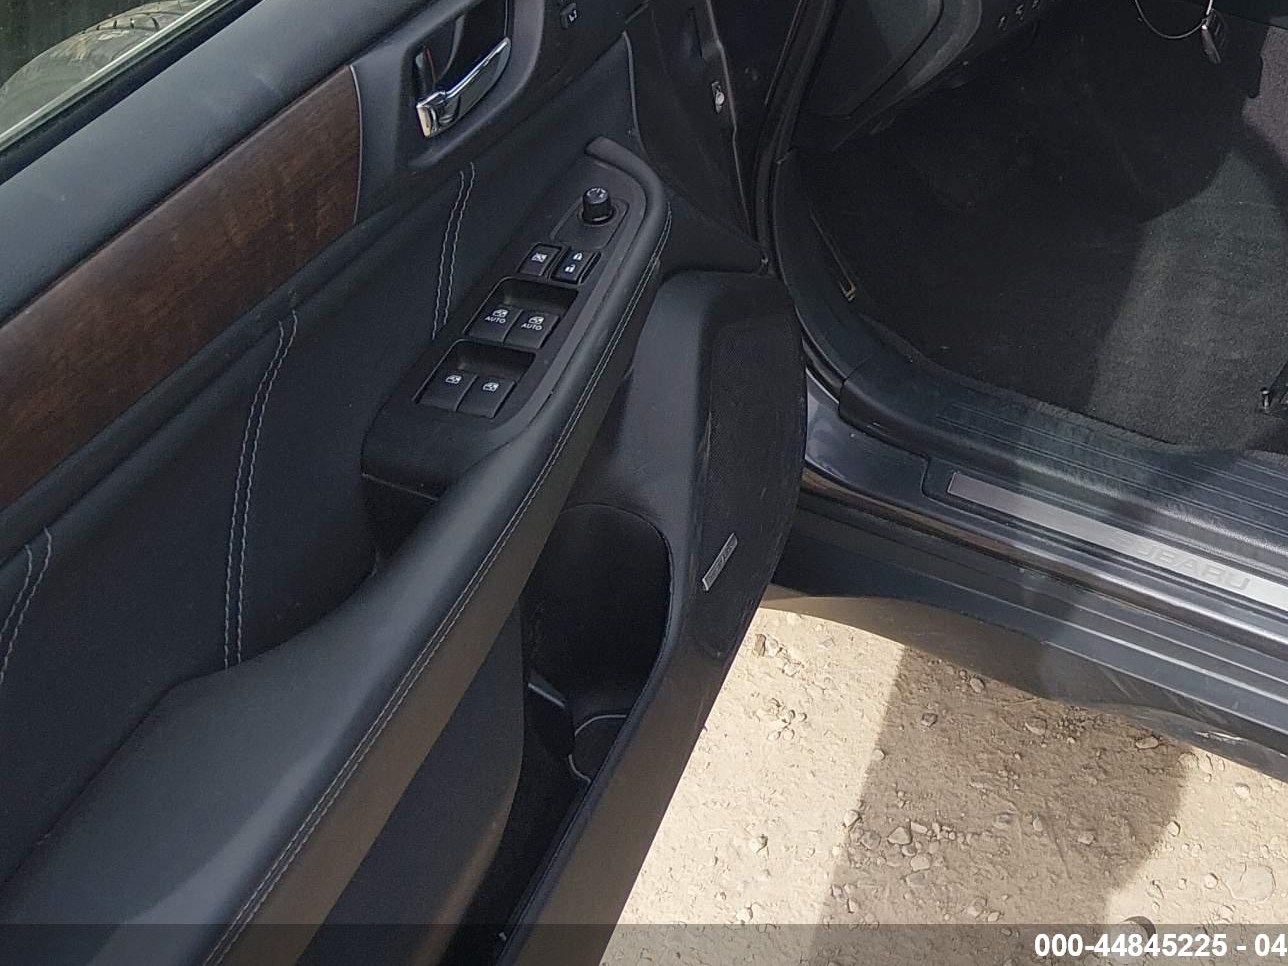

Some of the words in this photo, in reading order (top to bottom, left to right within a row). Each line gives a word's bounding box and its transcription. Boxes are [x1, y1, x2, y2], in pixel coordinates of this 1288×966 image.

[485, 316, 506, 324] AUTO
[521, 323, 543, 331] AUTO
[1111, 533, 1250, 591] SUBARU
